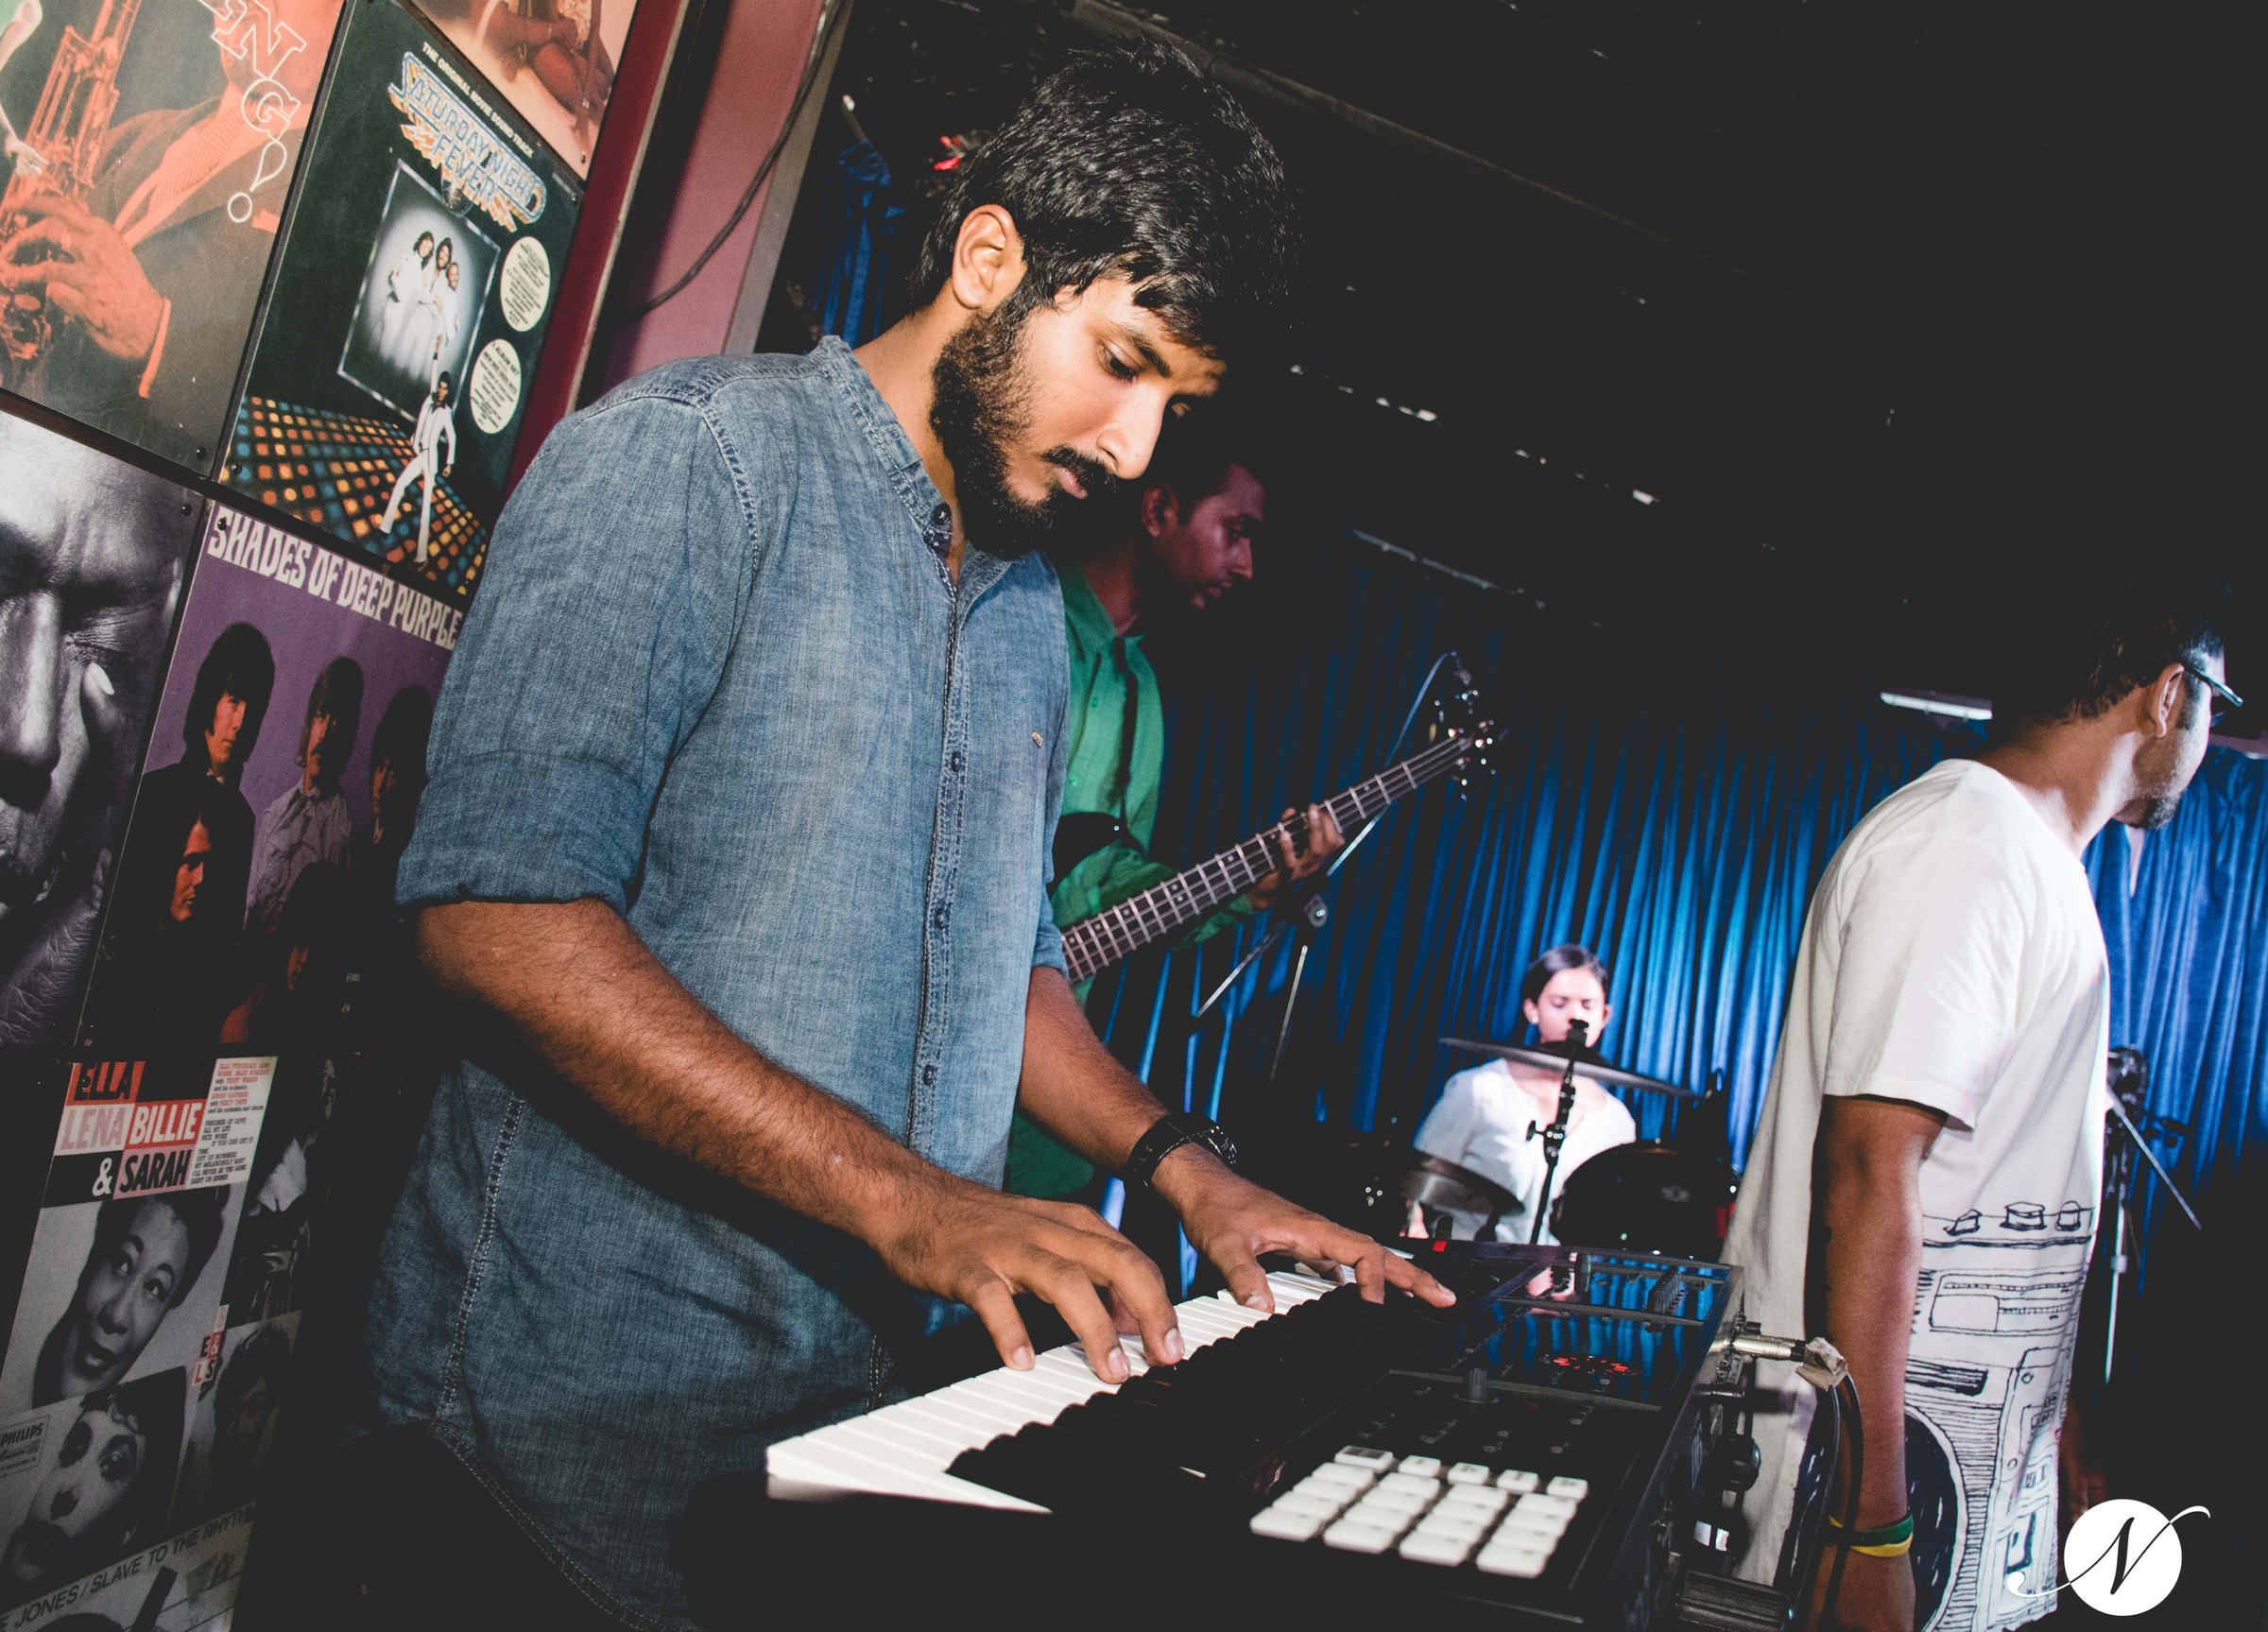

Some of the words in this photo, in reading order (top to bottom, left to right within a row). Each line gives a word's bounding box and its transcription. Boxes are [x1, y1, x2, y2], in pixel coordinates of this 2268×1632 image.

[198, 0, 308, 223] NG!
[388, 51, 490, 159] SATURDAY
[488, 151, 546, 219] NIGHT
[422, 42, 439, 63] THE
[438, 58, 471, 95] ORIGINAL
[470, 90, 493, 117] MOVIE
[490, 112, 515, 139] SOUND
[513, 133, 534, 159] TRACK
[432, 132, 499, 205] FEVER
[207, 505, 314, 590] SHADES
[307, 546, 344, 602] OF
[336, 559, 395, 623] DEEP
[388, 578, 464, 651] PURPLE
[74, 1061, 132, 1101] ELLA
[60, 1108, 126, 1150] LENA
[129, 1102, 203, 1145] BILLIE
[92, 1157, 114, 1197] &
[120, 1149, 193, 1193] SARAH
[0, 1422, 43, 1448] PHILIPS
[14, 1585, 79, 1628] JONES
[91, 1555, 143, 1593] SLAVE
[149, 1545, 168, 1566] TO
[173, 1532, 198, 1555] THE
